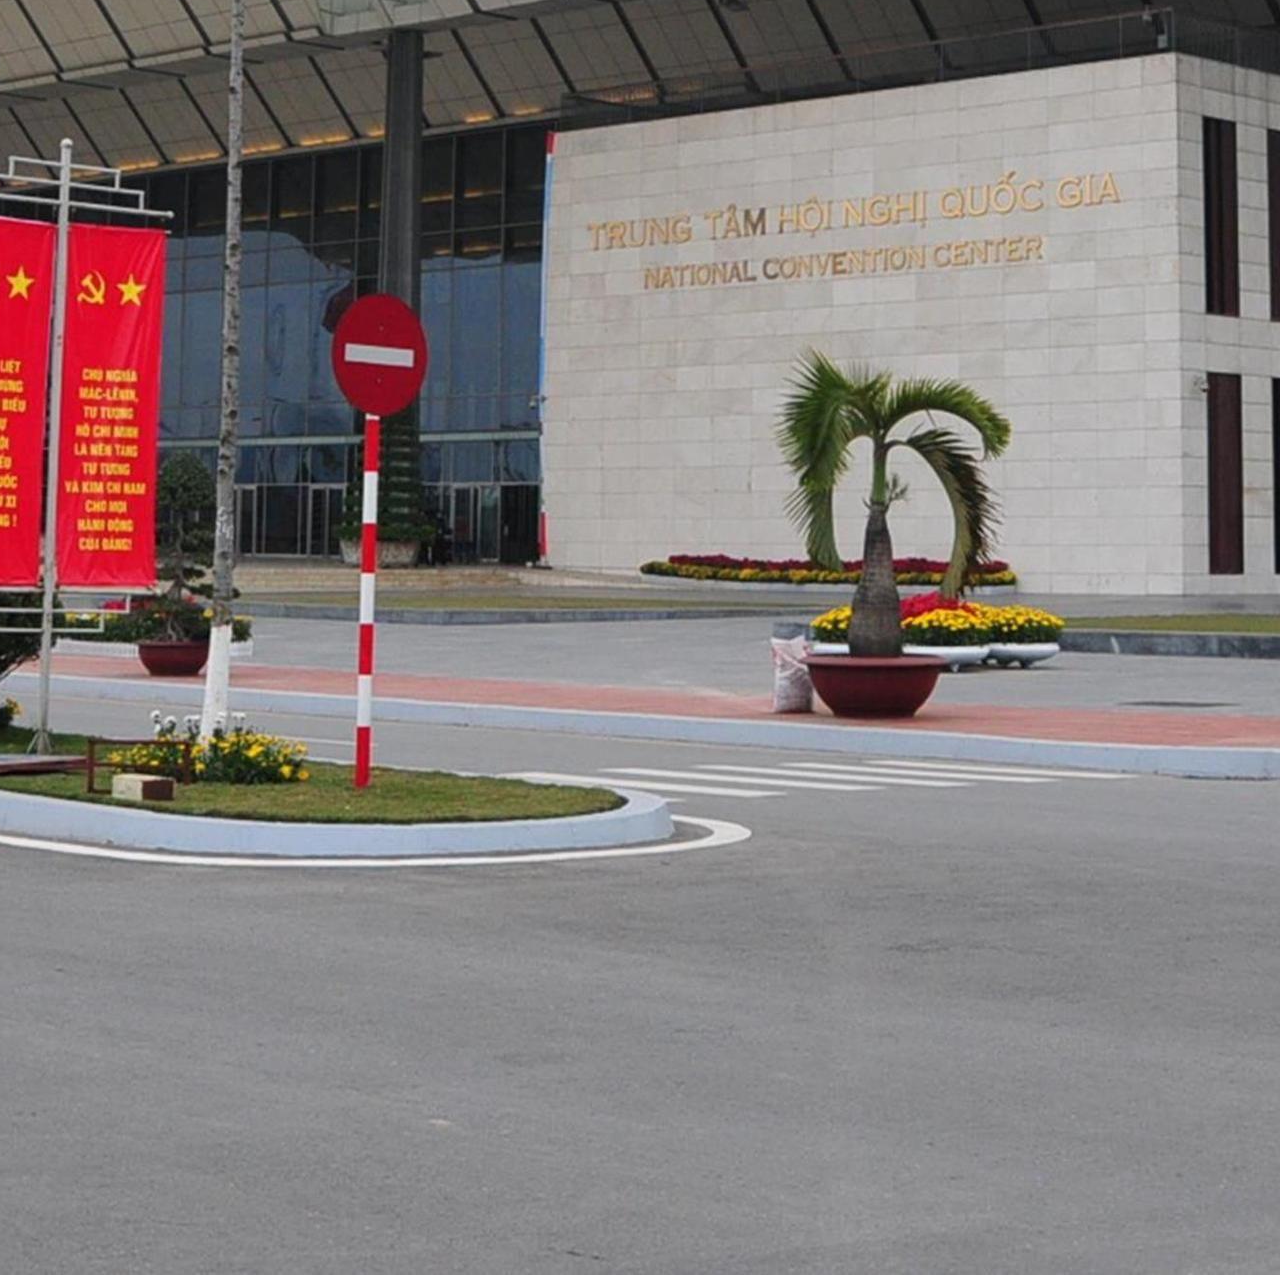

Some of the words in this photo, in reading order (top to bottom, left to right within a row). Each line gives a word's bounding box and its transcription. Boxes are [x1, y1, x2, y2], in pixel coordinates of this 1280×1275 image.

[587, 213, 692, 251] TRUNG
[704, 203, 765, 240] TÂM
[779, 194, 833, 238] HỘI
[842, 190, 927, 228] NGHỊ
[939, 170, 1045, 219] QUỐC
[1057, 172, 1121, 208] GIA
[644, 259, 757, 290] NATIONAL
[762, 245, 926, 281] CONVENTION
[933, 235, 1043, 267] CENTER
